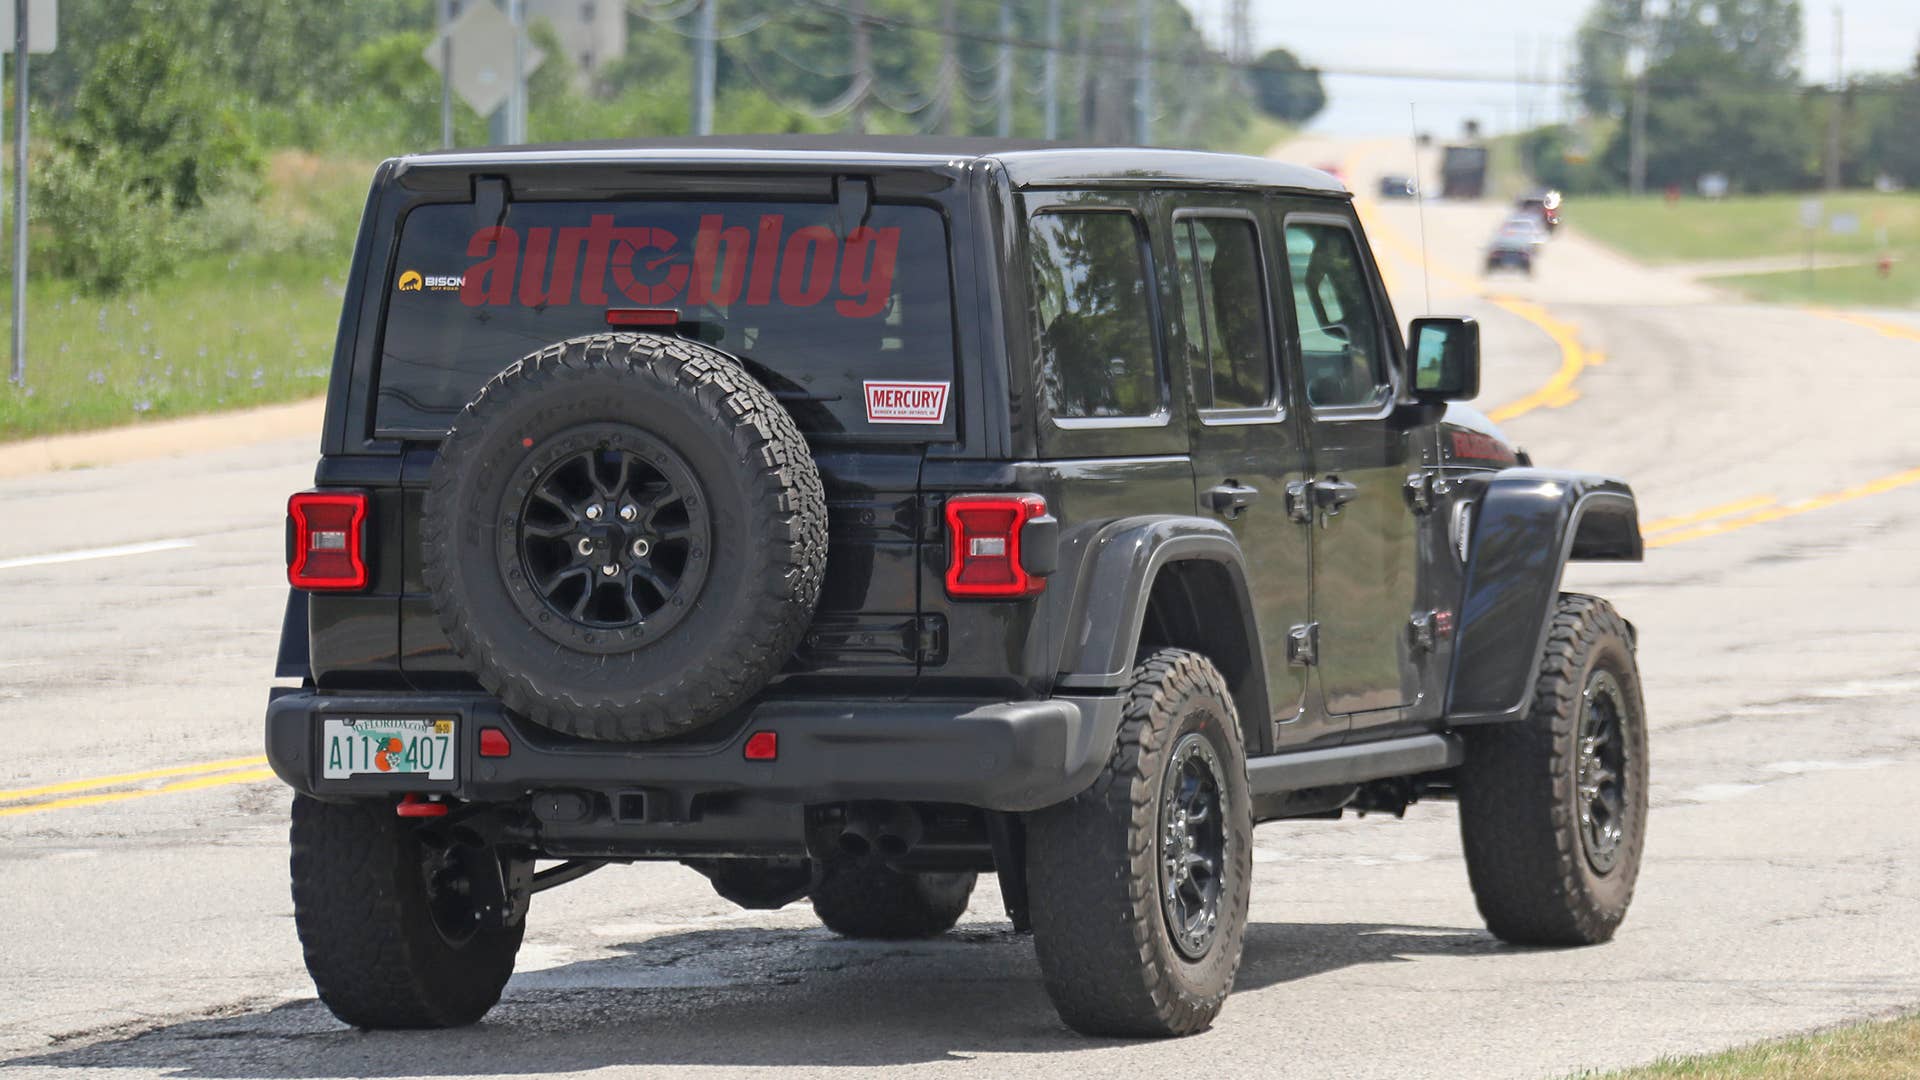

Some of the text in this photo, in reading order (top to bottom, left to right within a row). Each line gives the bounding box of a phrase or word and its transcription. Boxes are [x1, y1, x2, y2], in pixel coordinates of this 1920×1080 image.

[425, 276, 466, 287] BISON
[873, 390, 939, 408] MERCURY
[329, 735, 449, 770] A11 407
